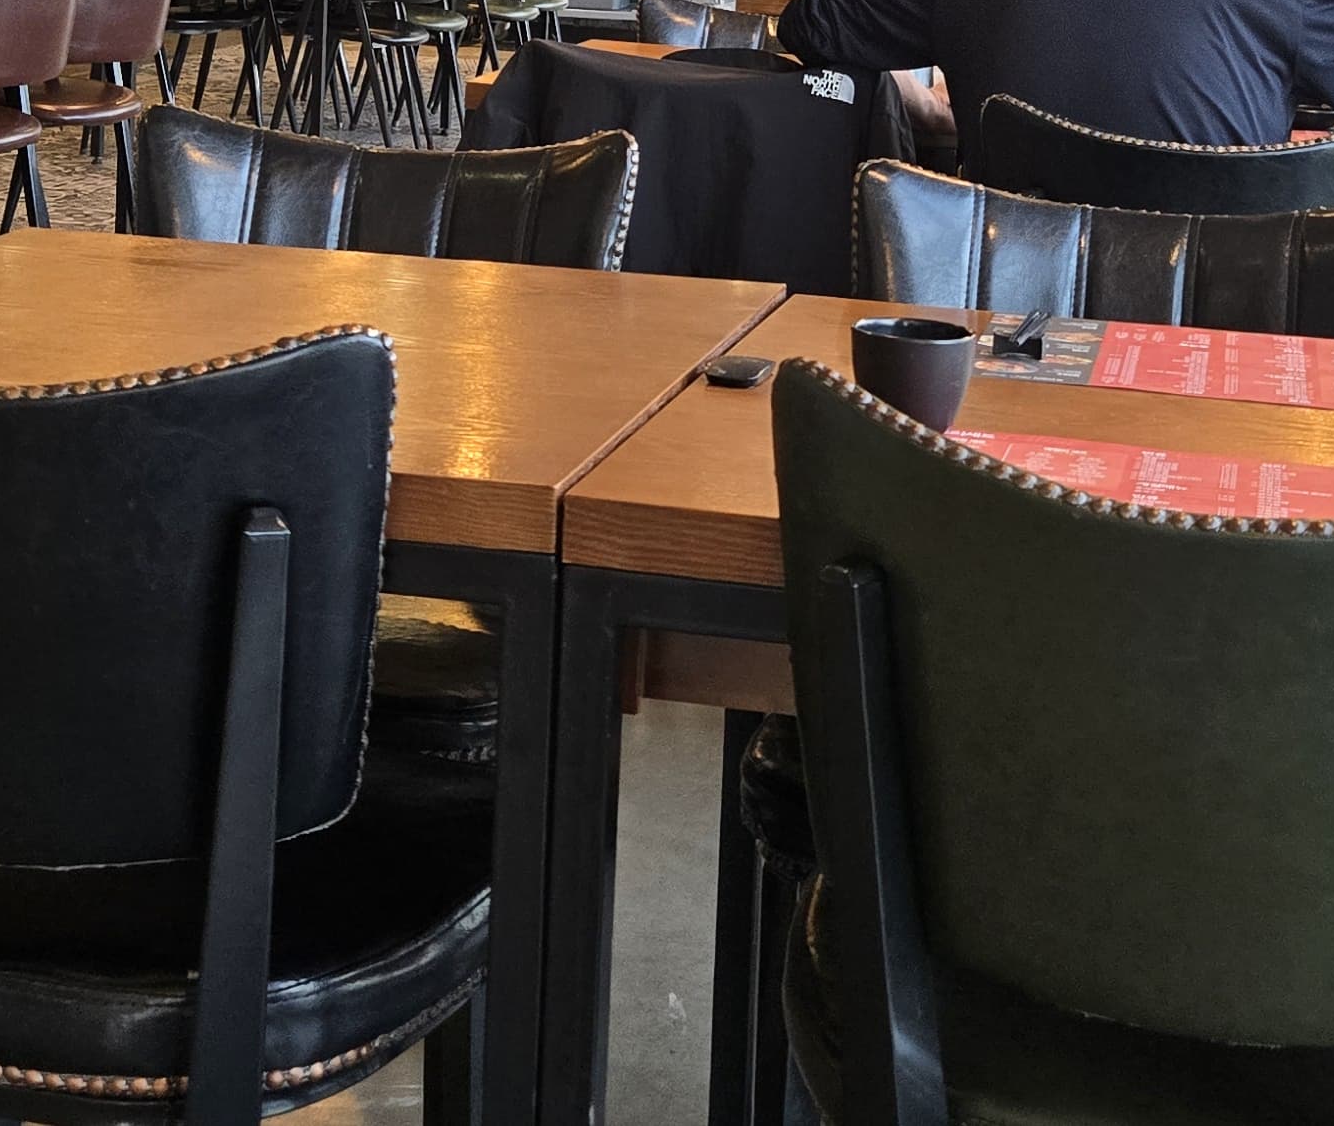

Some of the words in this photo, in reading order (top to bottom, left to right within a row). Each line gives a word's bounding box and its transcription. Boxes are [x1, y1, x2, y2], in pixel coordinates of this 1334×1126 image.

[803, 74, 841, 92] NORTH
[822, 69, 844, 83] THE
[811, 85, 841, 100] FACE
